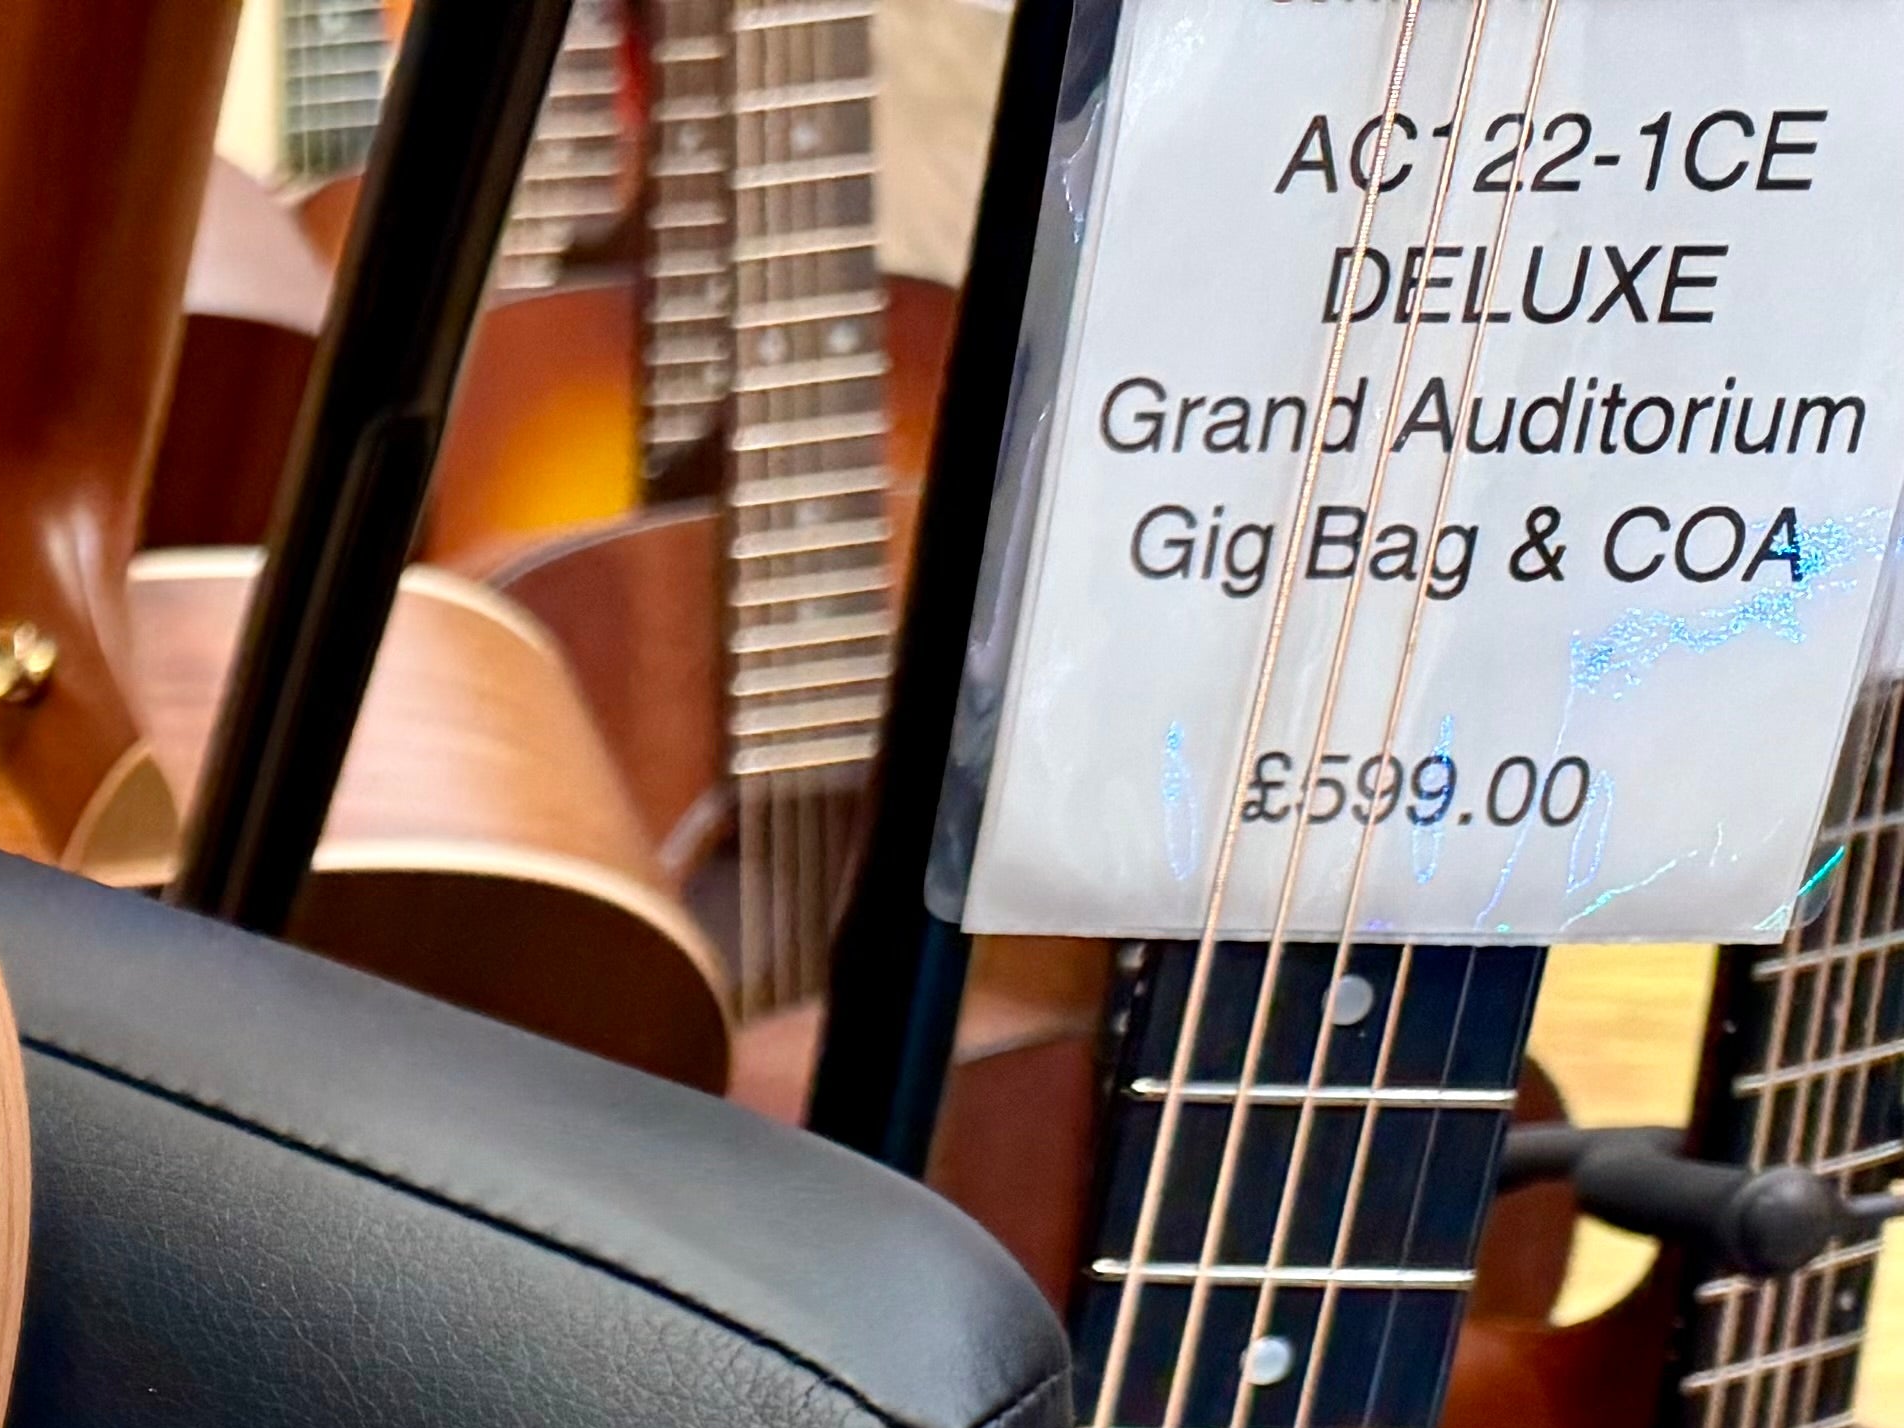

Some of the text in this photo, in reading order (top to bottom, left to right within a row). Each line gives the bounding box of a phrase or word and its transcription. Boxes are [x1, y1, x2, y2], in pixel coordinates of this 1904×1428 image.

[1274, 109, 1829, 194] AC22-1CE
[1320, 244, 1729, 325] DELUXE
[1099, 376, 1867, 456] Grand Auditorium
[1130, 504, 1805, 600] Gig Bag & COA
[1239, 751, 1592, 827] £599.00
